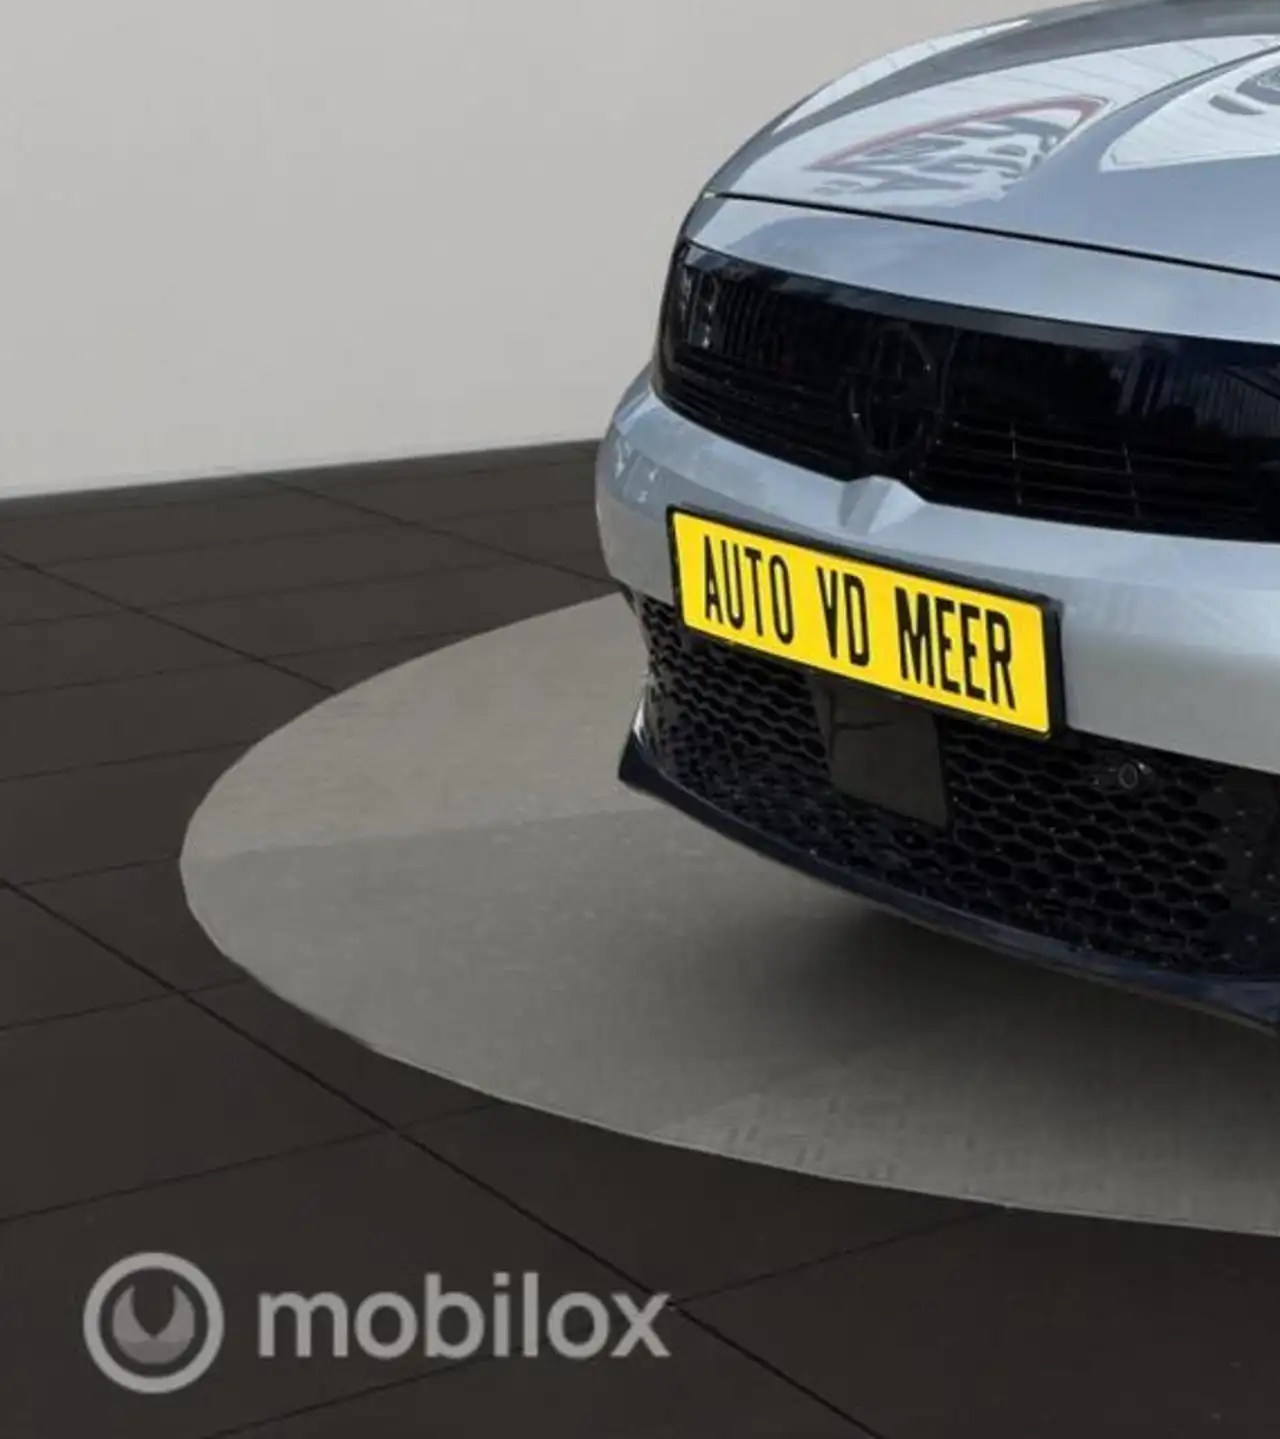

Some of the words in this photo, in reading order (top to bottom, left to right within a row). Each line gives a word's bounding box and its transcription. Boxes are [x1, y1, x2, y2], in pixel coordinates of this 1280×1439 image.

[704, 534, 795, 645] AUTO
[816, 565, 870, 667] VD
[895, 586, 1017, 710] MEER
